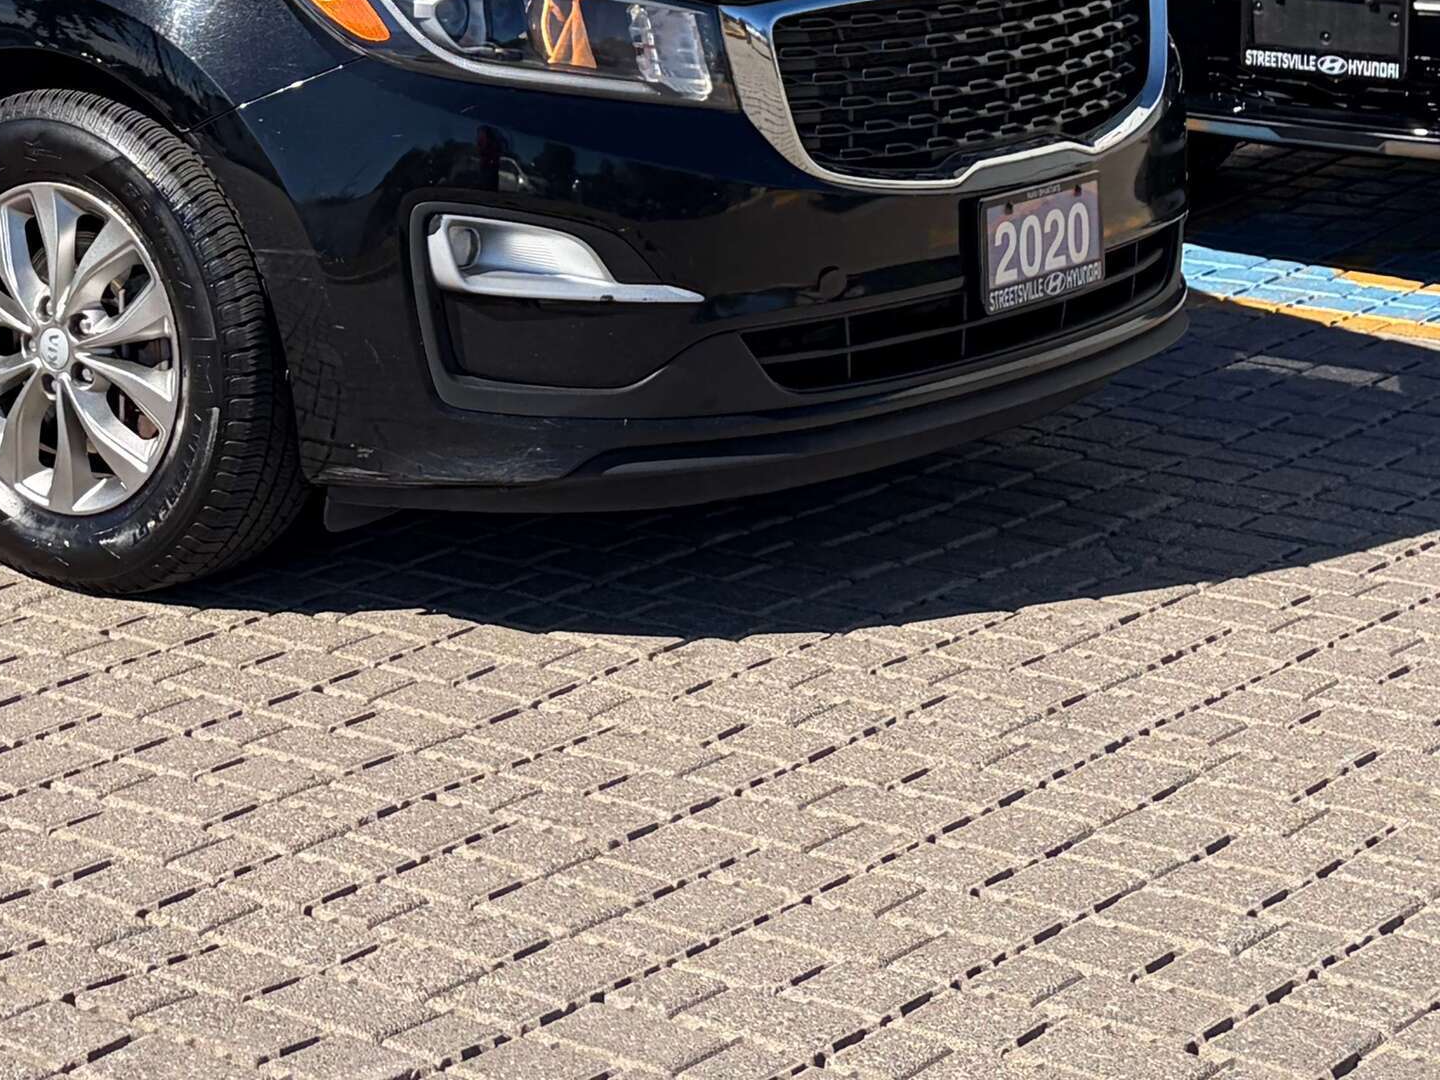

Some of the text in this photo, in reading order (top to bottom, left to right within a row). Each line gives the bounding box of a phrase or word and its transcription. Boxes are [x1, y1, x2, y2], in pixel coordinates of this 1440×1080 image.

[1245, 49, 1400, 79] STREETSVILLE HYUNDAI
[994, 202, 1090, 286] 2020
[989, 261, 1102, 312] STREETSVILLE HYUNDAI
